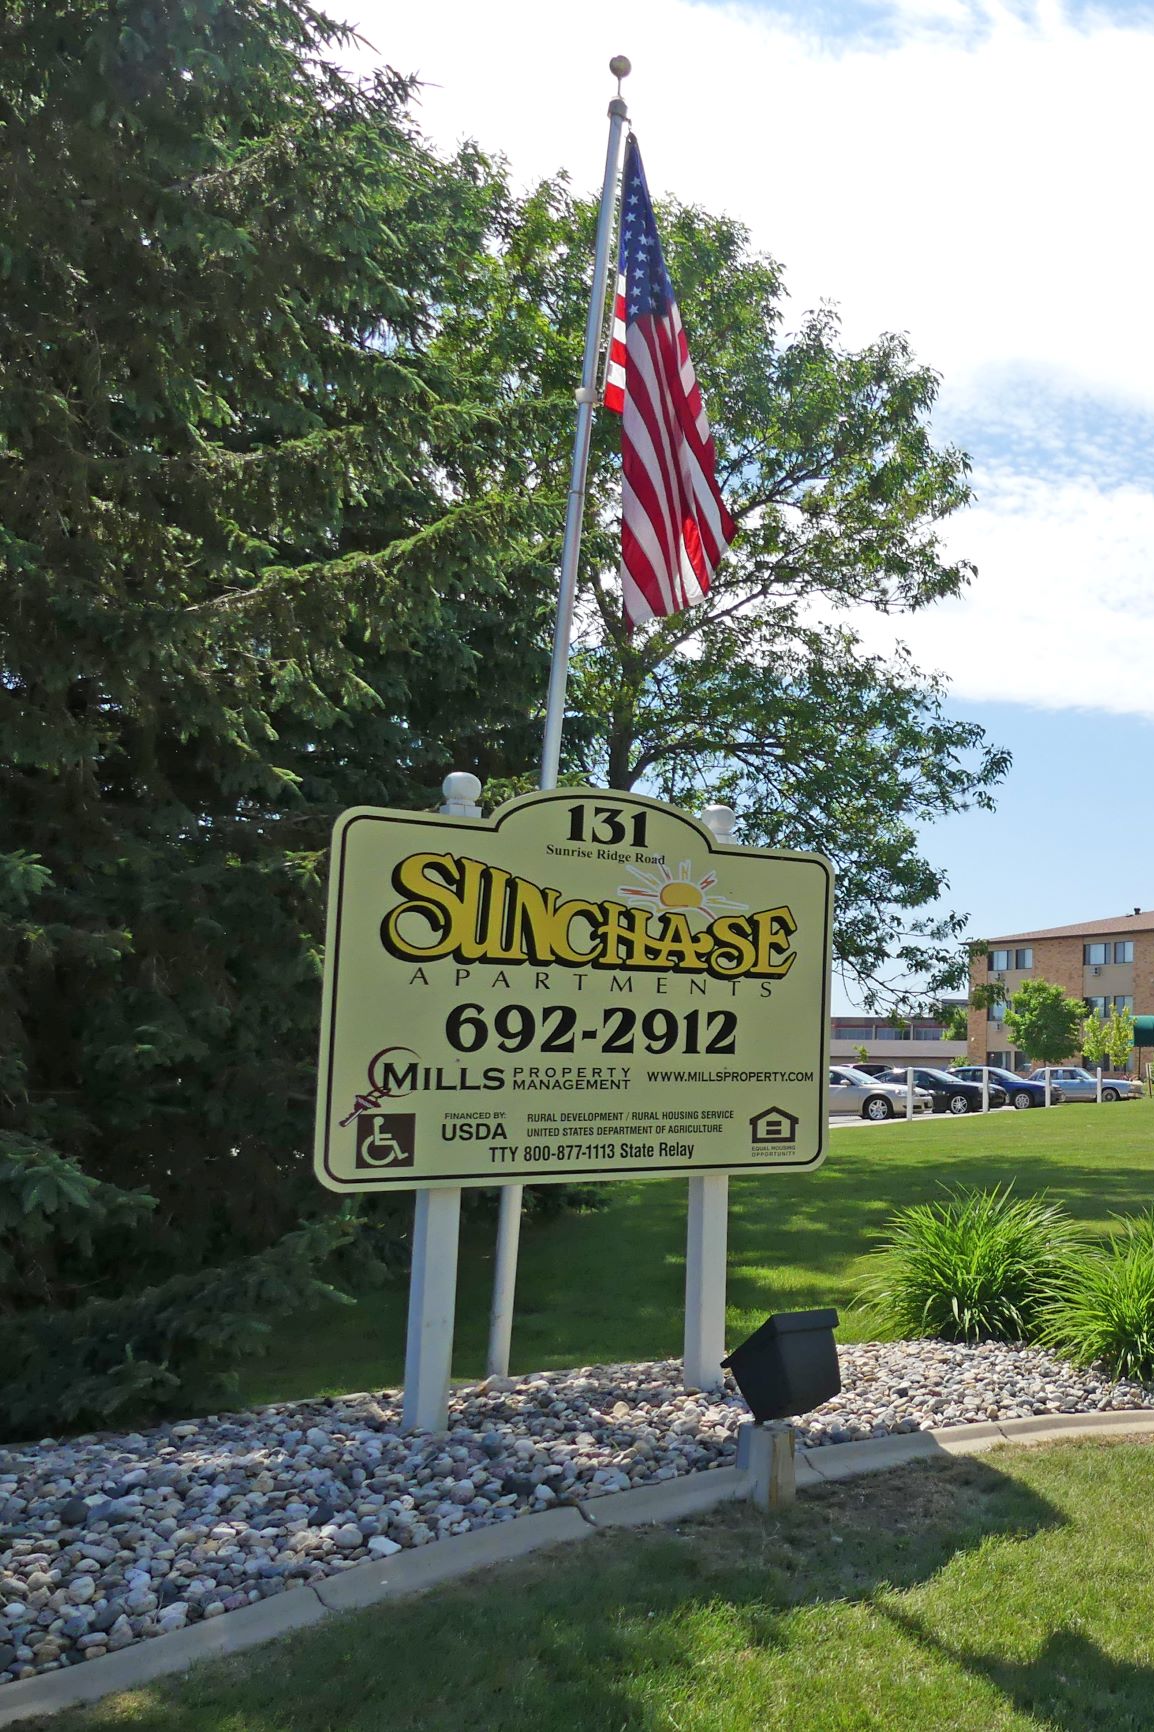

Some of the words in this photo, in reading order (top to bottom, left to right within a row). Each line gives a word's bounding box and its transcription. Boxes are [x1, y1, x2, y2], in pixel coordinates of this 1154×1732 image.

[566, 804, 648, 848] 131
[546, 844, 593, 858] Sunrise
[597, 849, 632, 864] Ridge
[635, 852, 665, 865] Road
[380, 852, 799, 980] SUNCHASE
[409, 967, 772, 998] APARTMENTS
[445, 1003, 738, 1054] 692-2912
[383, 1062, 505, 1091] MILLS
[513, 1067, 631, 1079] PROPERTY
[647, 1071, 814, 1082] WWW.MILLSPROPERTY.COM
[513, 1079, 631, 1091] MANAGEMENT
[444, 1112, 490, 1120] FINANCED
[527, 1113, 557, 1122] RURAL
[560, 1112, 624, 1122] DEVELOPMENT
[631, 1111, 659, 1121] RURAL
[662, 1111, 699, 1120] HOUSING
[701, 1110, 734, 1120] SERVICE
[441, 1123, 508, 1141] USDA
[527, 1128, 558, 1138] UNITED
[562, 1127, 594, 1137] STATES
[597, 1126, 652, 1136] DEPARTMENT
[655, 1126, 666, 1135] OF
[668, 1124, 723, 1135] AGRICULTURE
[489, 1146, 519, 1162] TTY
[524, 1144, 615, 1161] 800-877-1113
[620, 1143, 654, 1159] State
[659, 1142, 694, 1159] Relay
